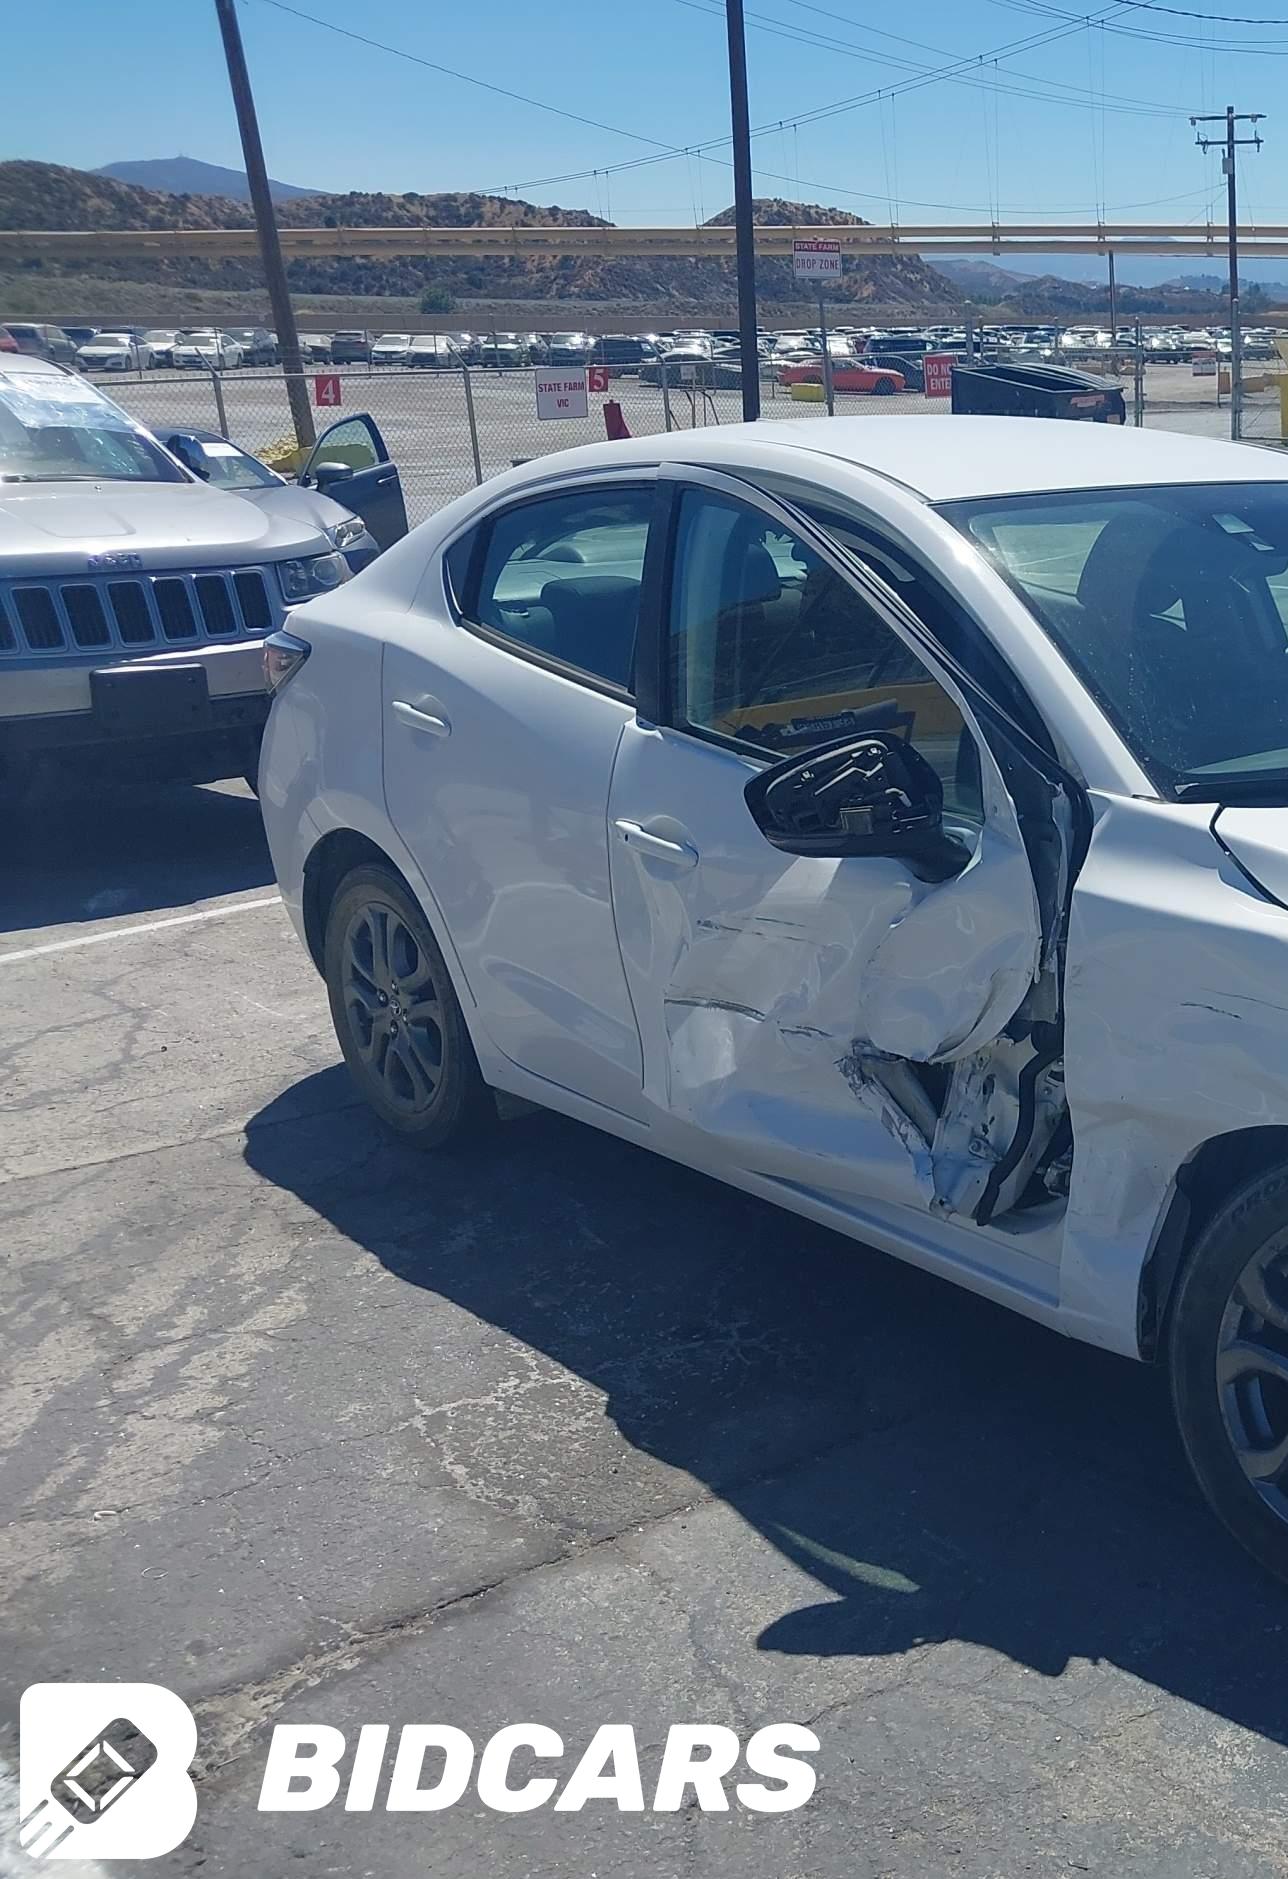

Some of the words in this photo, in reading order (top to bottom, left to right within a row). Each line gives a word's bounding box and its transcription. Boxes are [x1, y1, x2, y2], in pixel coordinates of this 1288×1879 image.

[795, 242, 817, 250] STATE
[819, 243, 839, 251] FARM
[796, 258, 817, 269] DROP
[819, 259, 839, 270] ZONE
[927, 364, 938, 375] DO
[940, 364, 957, 375] NO
[593, 368, 605, 390] 5
[930, 379, 952, 390] ENTE
[321, 379, 336, 404] 4
[538, 382, 562, 392] STATE
[563, 382, 585, 391] FARM
[557, 398, 569, 408] VIC
